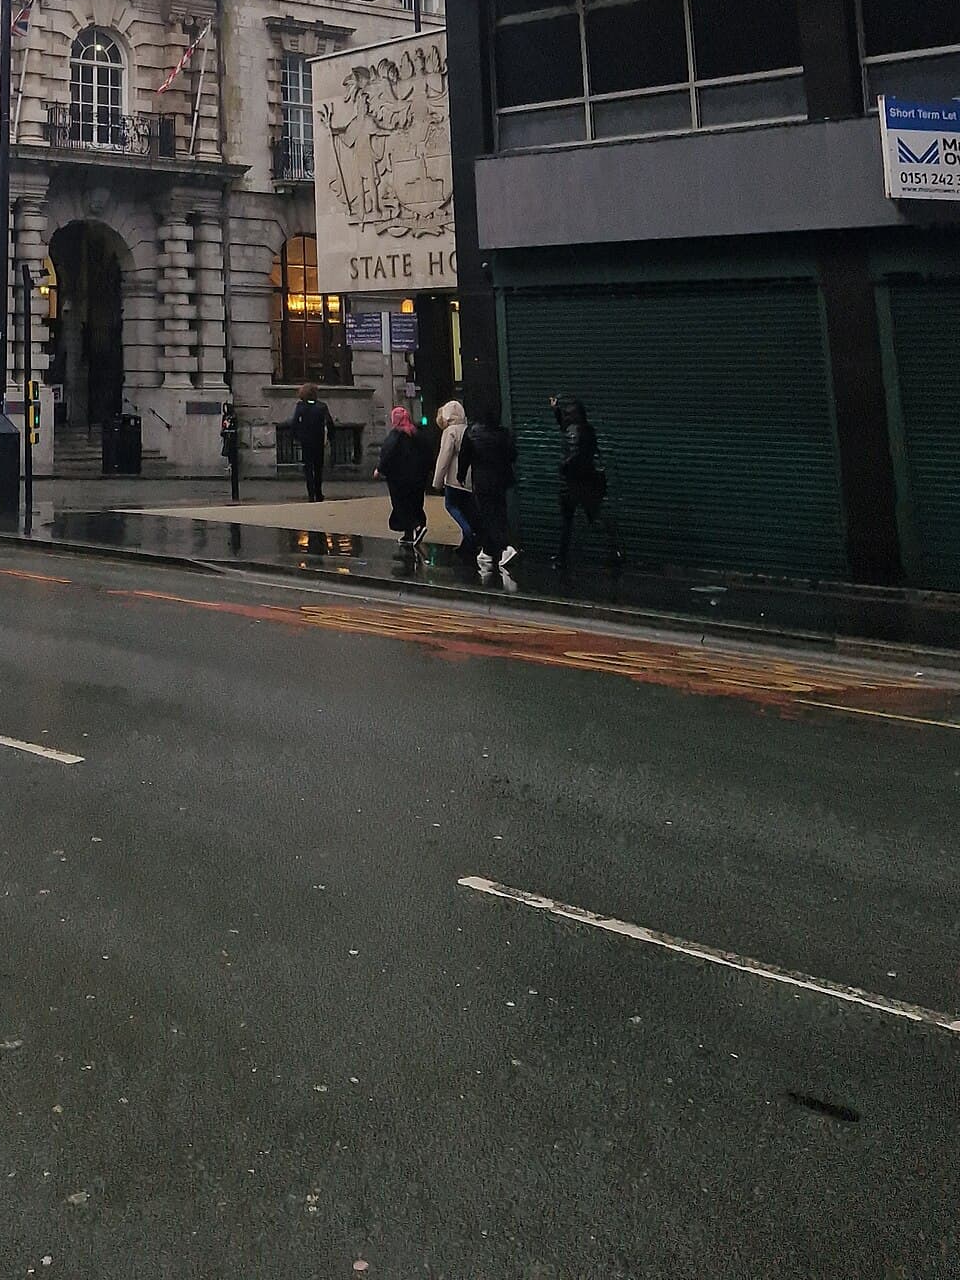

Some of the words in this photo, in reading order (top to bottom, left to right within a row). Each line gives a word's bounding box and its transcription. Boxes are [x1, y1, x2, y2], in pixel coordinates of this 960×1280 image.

[889, 107, 916, 119] Short
[916, 109, 940, 120] Term
[942, 137, 960, 151] M
[900, 171, 928, 185] 0151
[930, 173, 954, 186] 242
[350, 253, 412, 280] STATE
